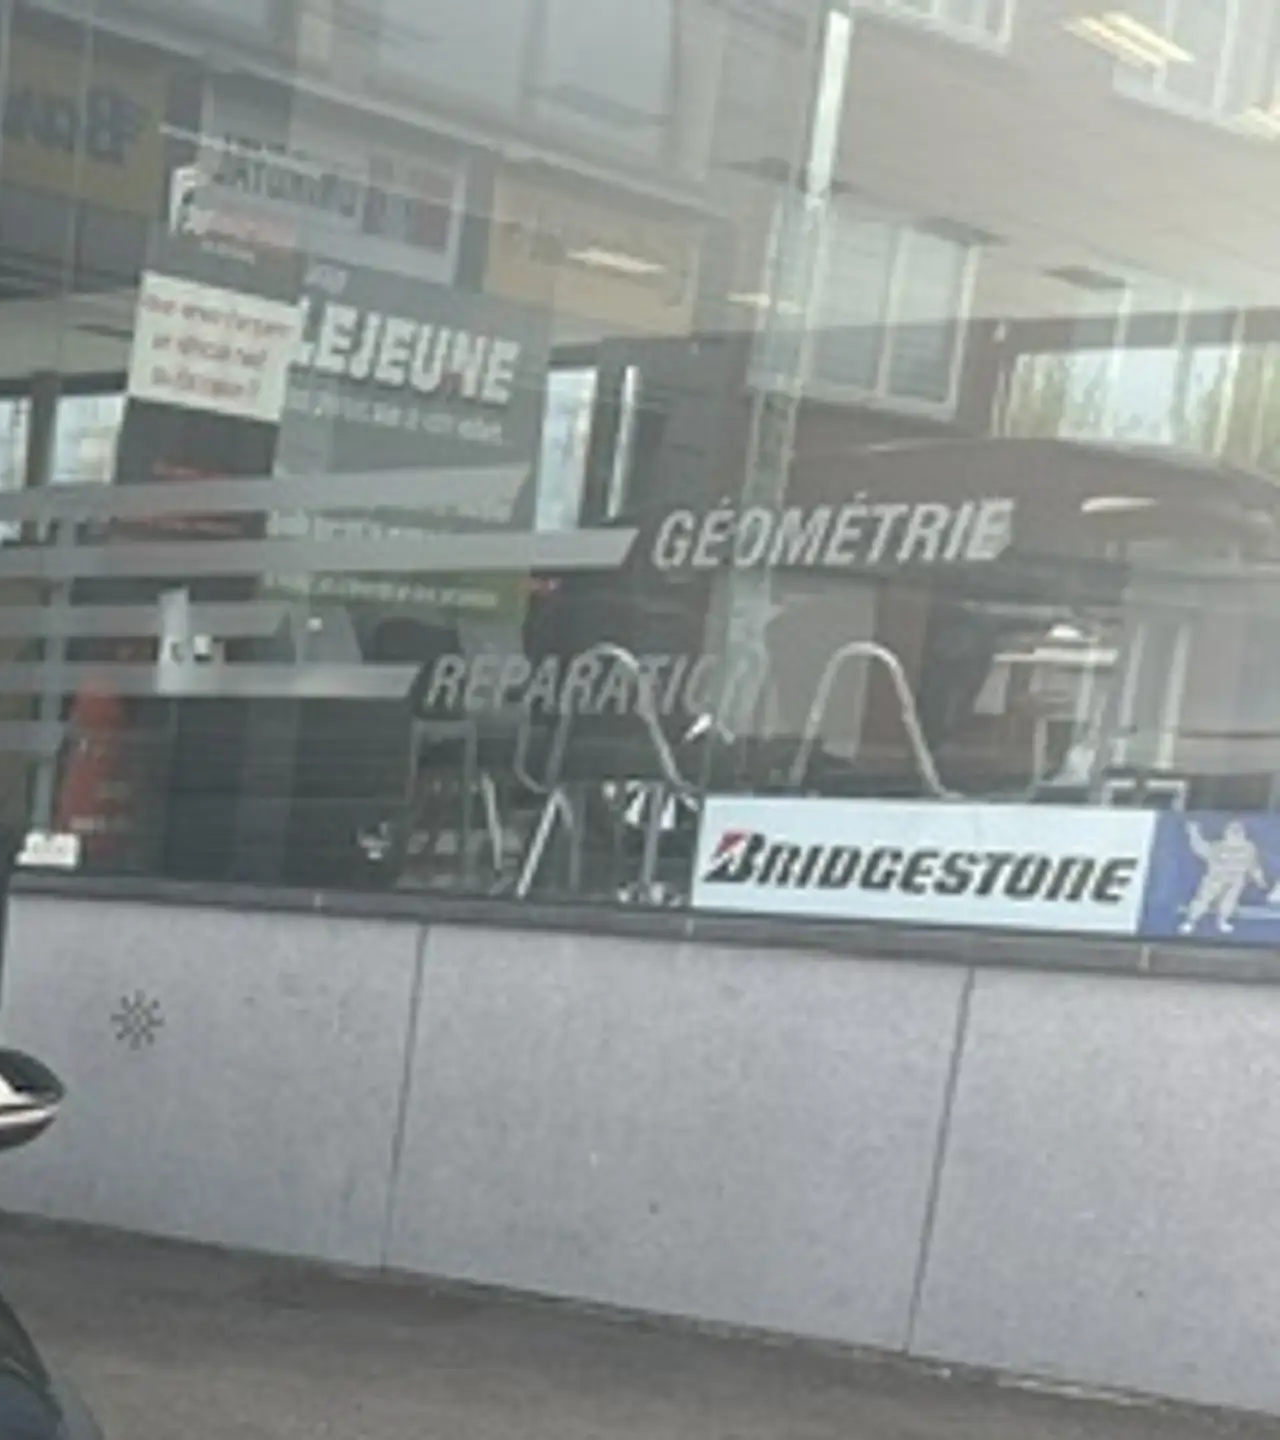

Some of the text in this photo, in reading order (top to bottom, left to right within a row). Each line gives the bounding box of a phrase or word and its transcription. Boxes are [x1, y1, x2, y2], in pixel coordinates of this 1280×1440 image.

[286, 297, 521, 405] LEJEUNE
[652, 490, 1016, 569] GÉOMÉTRIE
[703, 831, 1138, 903] BRIDGESTONE
